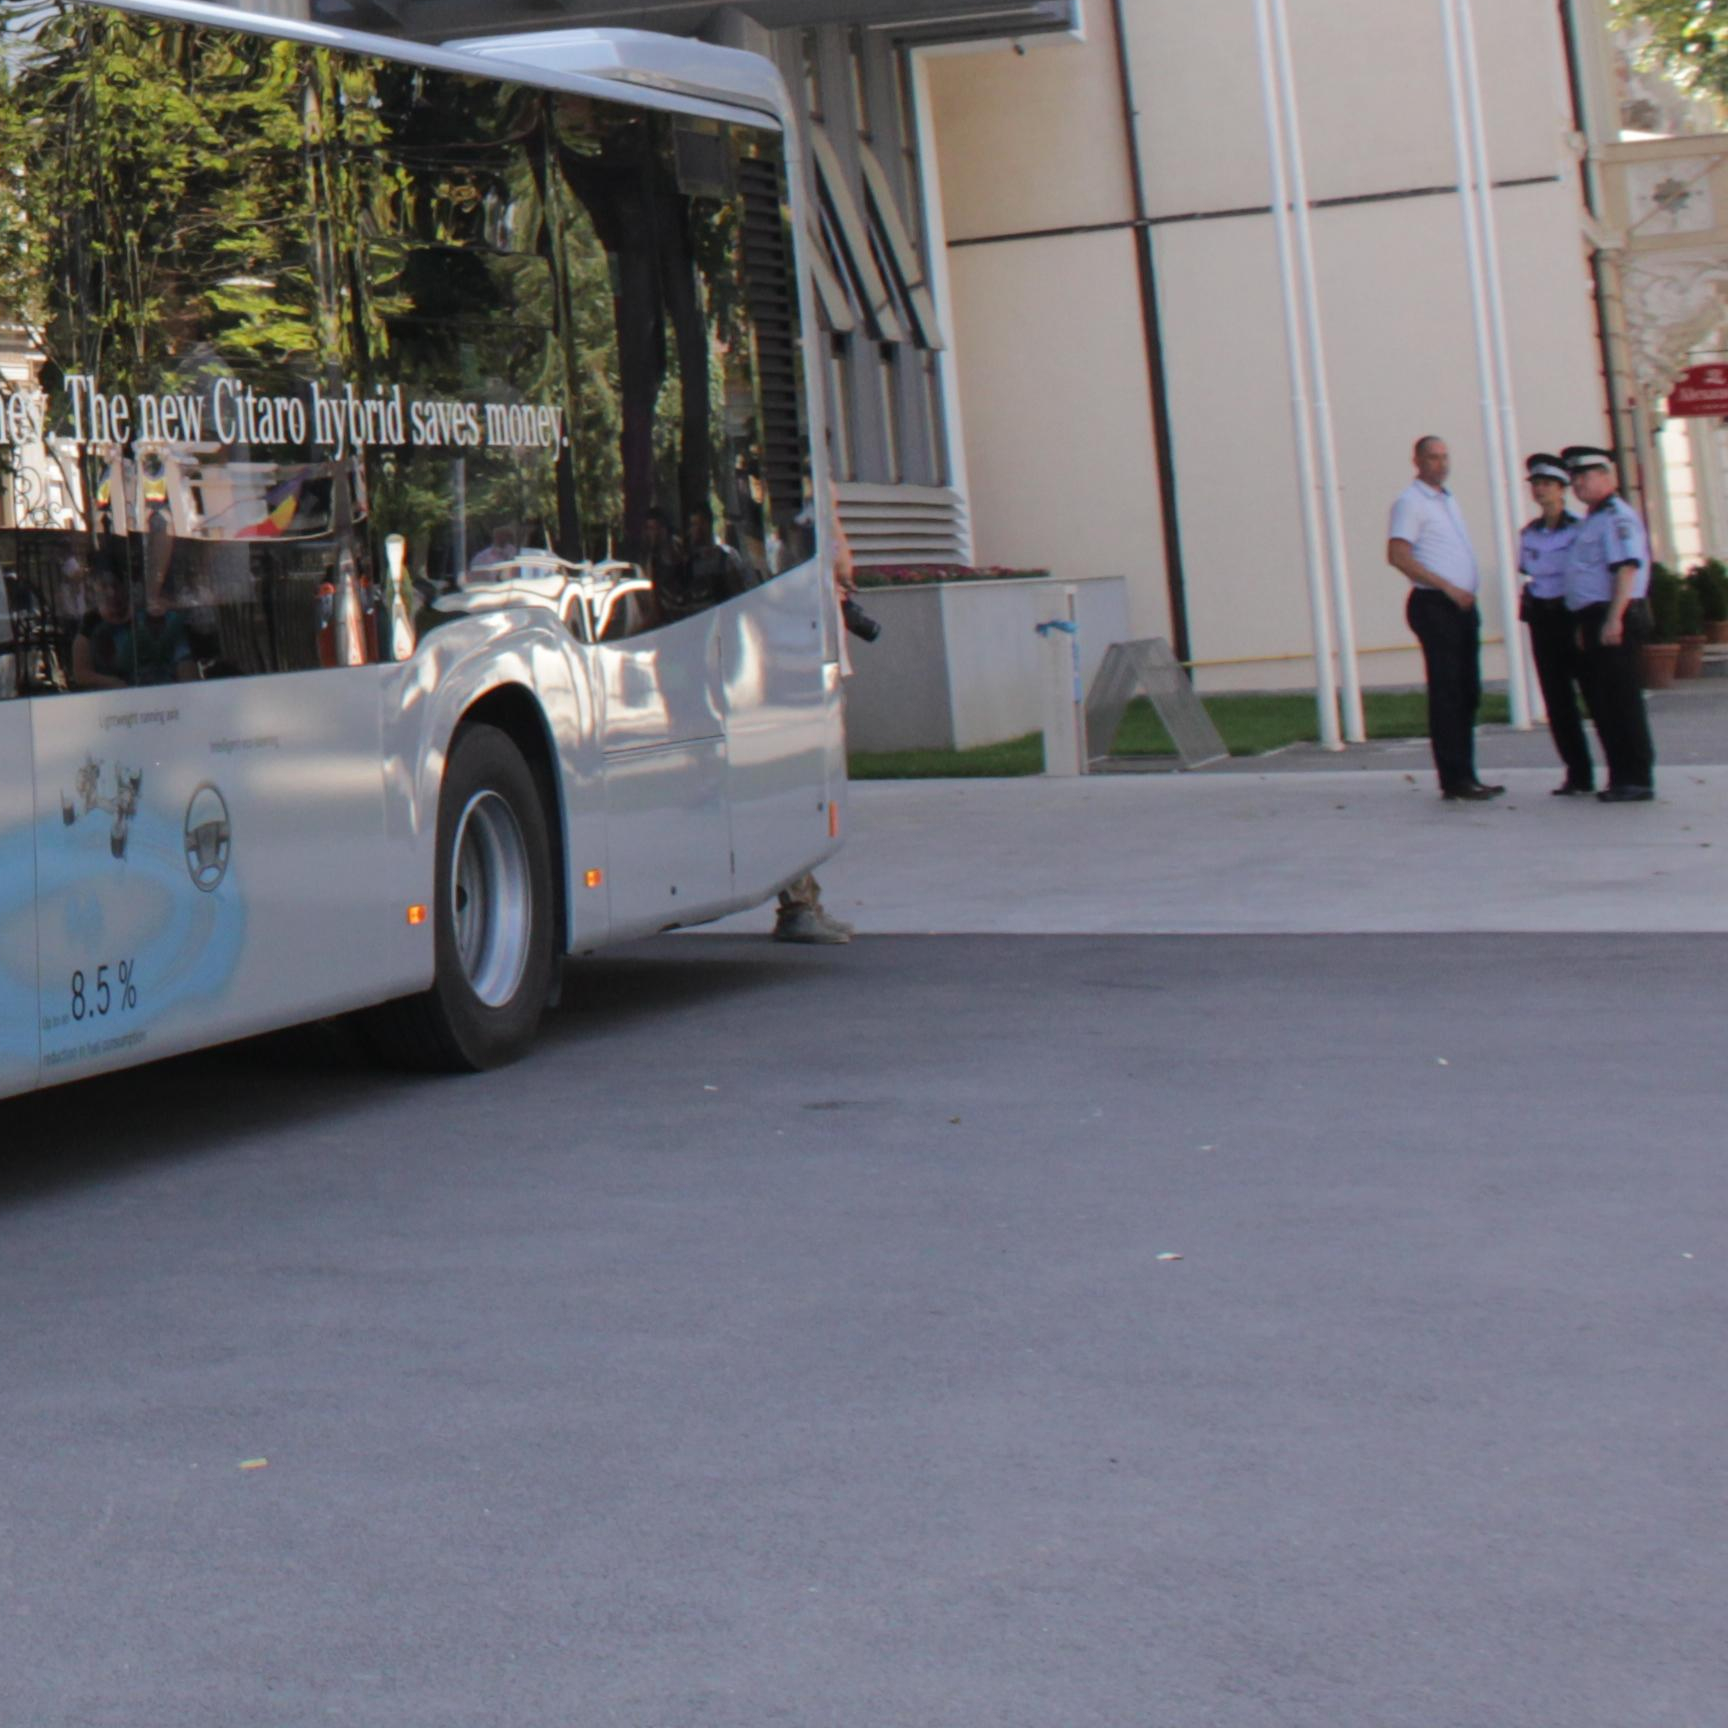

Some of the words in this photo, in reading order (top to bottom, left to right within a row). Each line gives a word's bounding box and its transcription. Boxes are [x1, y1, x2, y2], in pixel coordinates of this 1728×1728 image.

[63, 373, 131, 446] The
[139, 393, 206, 446] new
[213, 376, 306, 447] Citaro
[311, 381, 405, 463] hybrid
[411, 398, 481, 447] saves
[485, 402, 570, 463] money.
